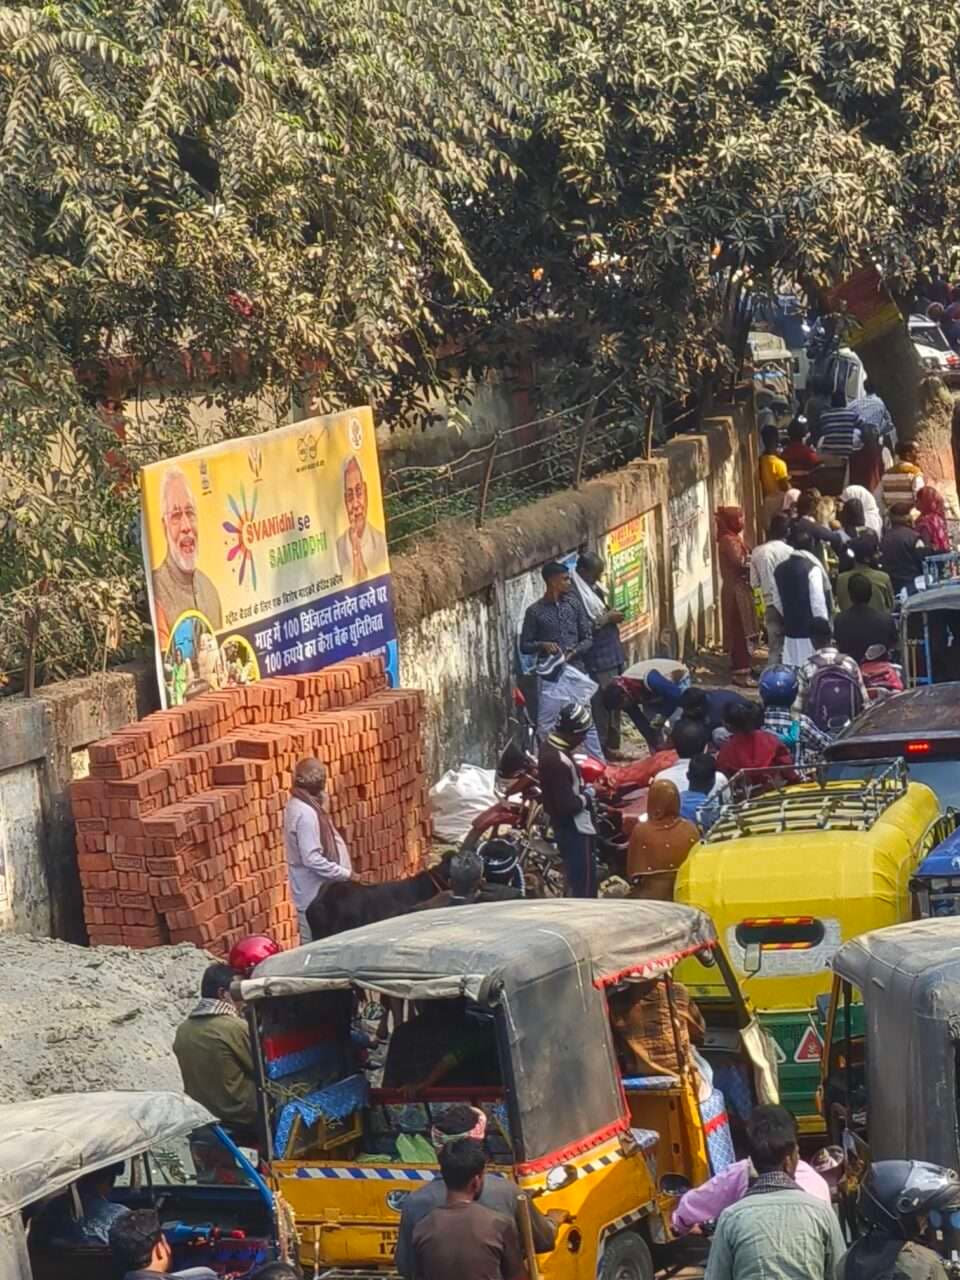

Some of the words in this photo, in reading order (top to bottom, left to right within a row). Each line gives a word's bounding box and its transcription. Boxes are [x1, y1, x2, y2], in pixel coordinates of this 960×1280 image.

[247, 512, 295, 543] SVANidhi
[297, 515, 310, 531] se
[269, 531, 327, 568] SAMRIDDHI
[255, 627, 273, 651] माह
[273, 620, 282, 643] में
[283, 617, 300, 640] 100
[300, 605, 332, 635] डिजिटल
[333, 595, 359, 622] लेनदेन
[358, 586, 377, 610] करने
[376, 585, 388, 603] पर
[264, 650, 282, 673] 100
[304, 639, 317, 659] का
